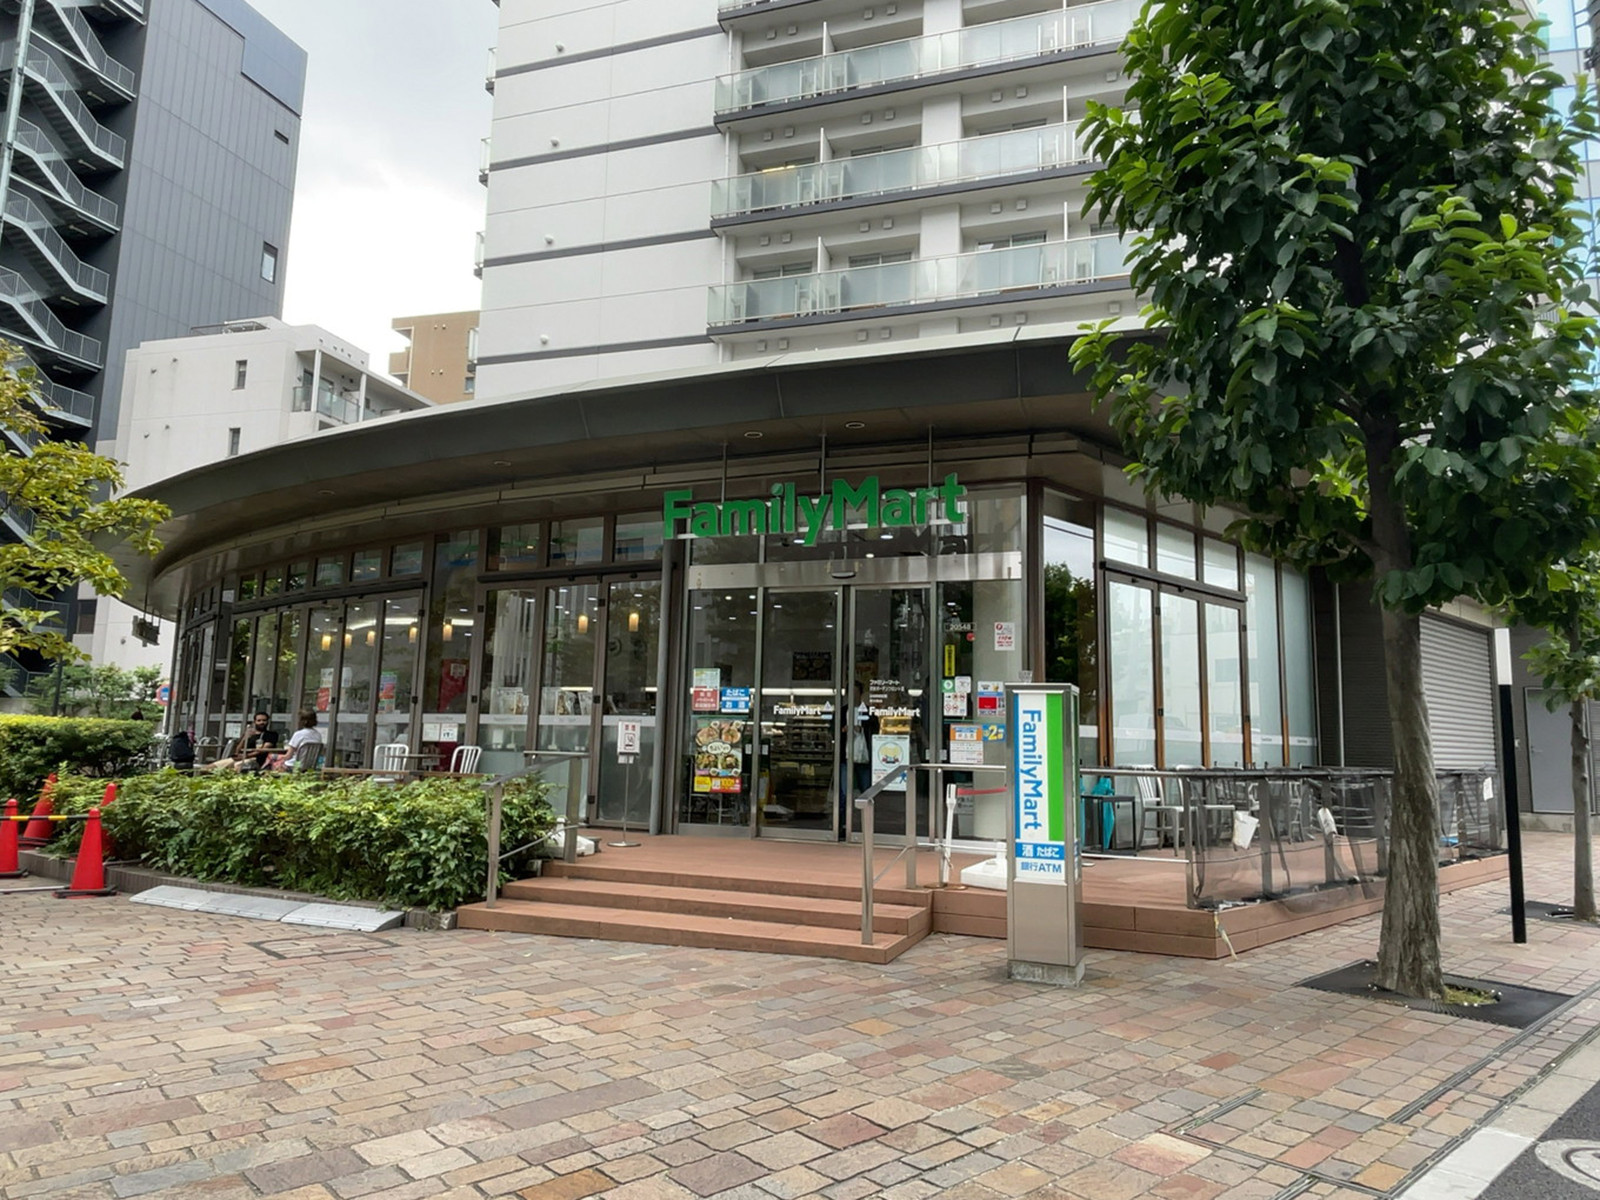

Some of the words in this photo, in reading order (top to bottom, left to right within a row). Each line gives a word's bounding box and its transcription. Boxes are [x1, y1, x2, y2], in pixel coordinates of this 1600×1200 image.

[664, 472, 967, 547] FamilyMart
[726, 689, 745, 697] たばこ
[773, 705, 821, 716] FamilyMart
[869, 706, 921, 718] FamilyMart
[1020, 709, 1043, 830] FamilyMart
[1036, 846, 1060, 858] たばこ
